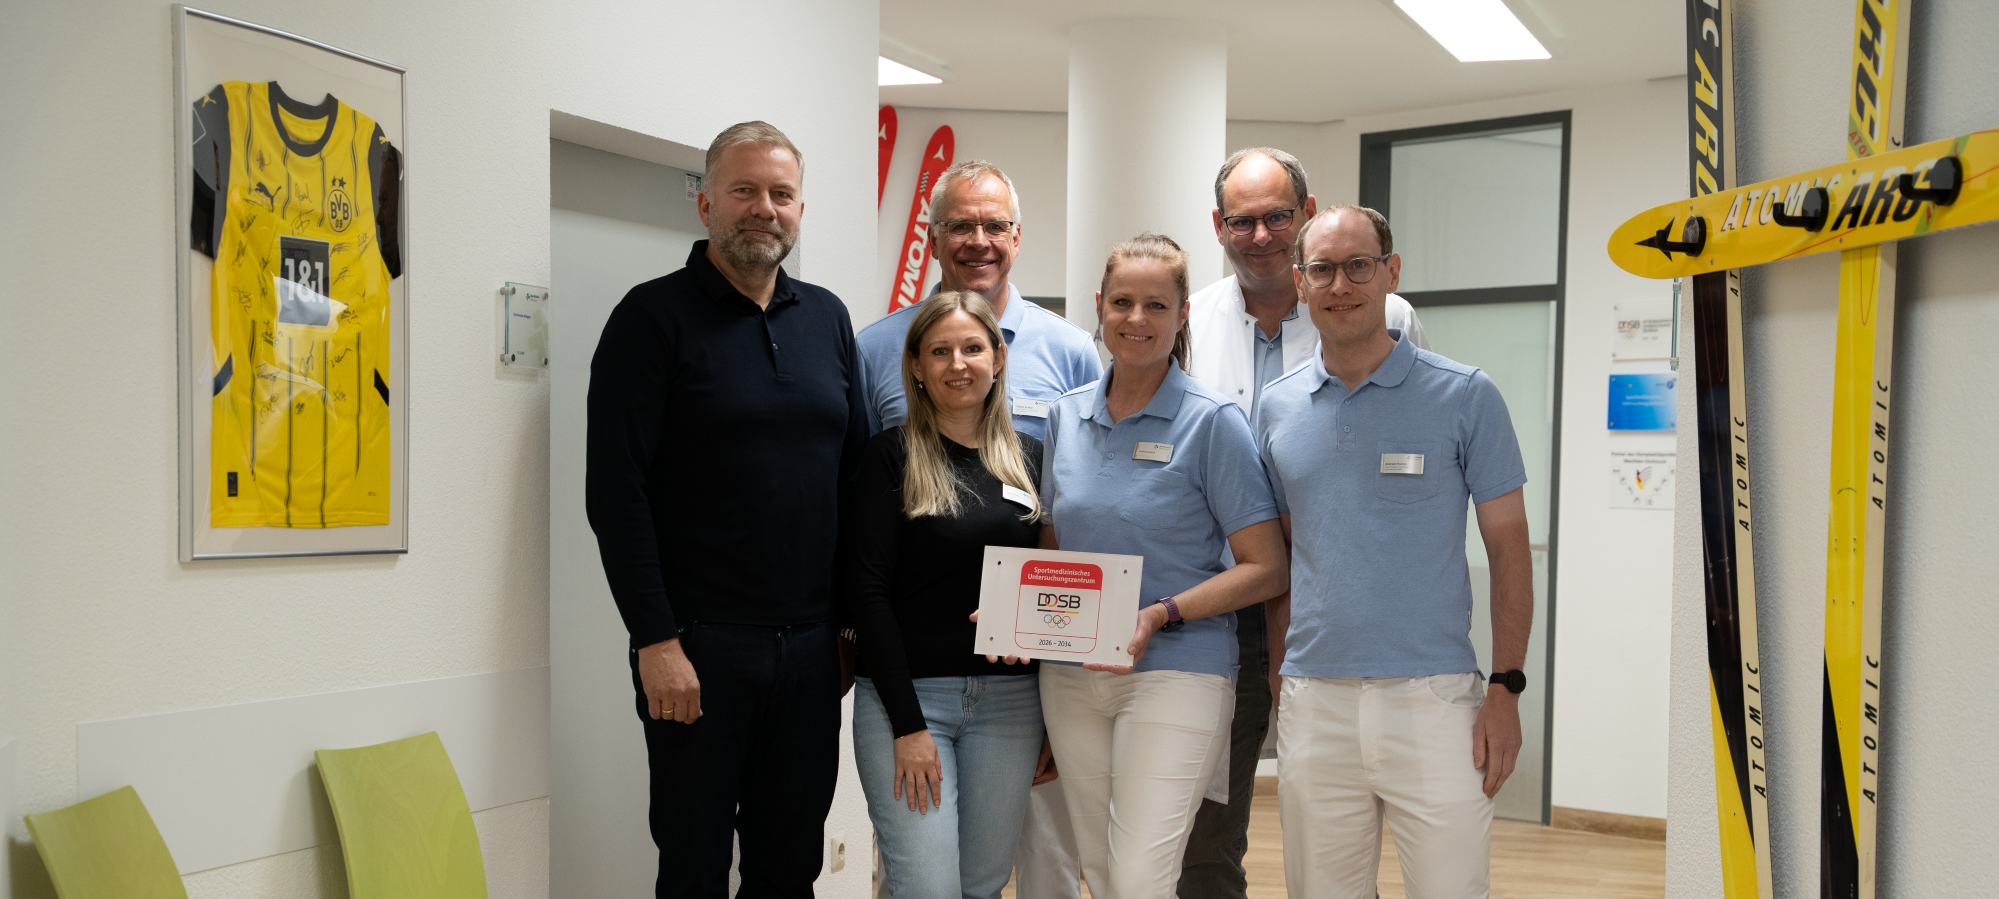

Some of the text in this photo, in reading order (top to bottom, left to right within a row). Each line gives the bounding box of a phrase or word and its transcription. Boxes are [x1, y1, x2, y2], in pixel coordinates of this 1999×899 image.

[1855, 0, 1890, 144] RC
[330, 193, 350, 221] BVB
[335, 219, 344, 229] 09
[284, 257, 325, 304] 1&1
[896, 195, 931, 310] ATOMI
[1734, 416, 1750, 531] ATOMIC
[1872, 380, 1888, 510] ATOMIC
[1027, 573, 1096, 584] Untersuchungszentrum
[1033, 566, 1091, 577] Sportmedizinisches
[1037, 592, 1081, 609] DOSB
[1746, 662, 1766, 799] ATOMIC
[1863, 655, 1879, 805] ATOMIC
